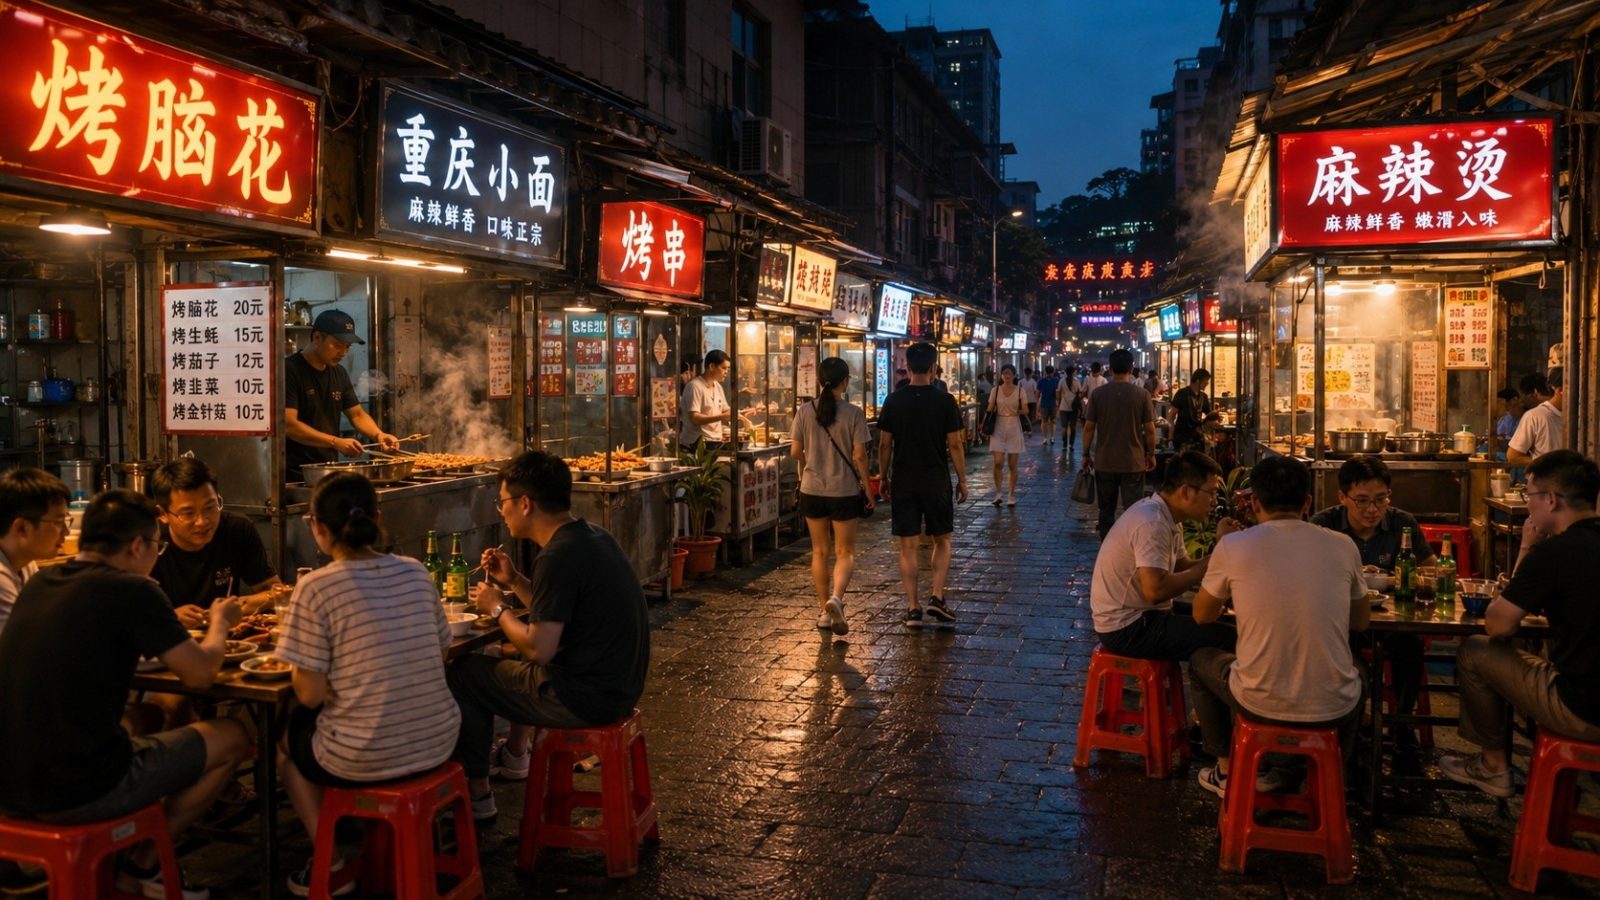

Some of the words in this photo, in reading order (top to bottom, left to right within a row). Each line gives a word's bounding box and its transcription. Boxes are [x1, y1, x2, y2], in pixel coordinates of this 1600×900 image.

[29, 38, 292, 204] 烤脑花
[397, 113, 555, 214] 重庆小面
[1307, 137, 1512, 206] 麻辣烫
[408, 196, 475, 233] 麻辣鲜香
[487, 216, 543, 246] 口味正宗
[1324, 211, 1405, 232] 麻辣鲜香
[1414, 208, 1499, 230] 嫩滑入味
[620, 209, 686, 288] 烤串
[233, 299, 264, 316] 20元
[172, 326, 219, 345] 烤生蚝
[234, 326, 264, 343] 15元
[172, 352, 220, 370] 烤茄子
[234, 352, 264, 369] 12元
[172, 377, 219, 395] 烤韭菜
[235, 378, 264, 395] 10元
[173, 403, 226, 420] 烤金针菇
[235, 403, 264, 420] 10元
